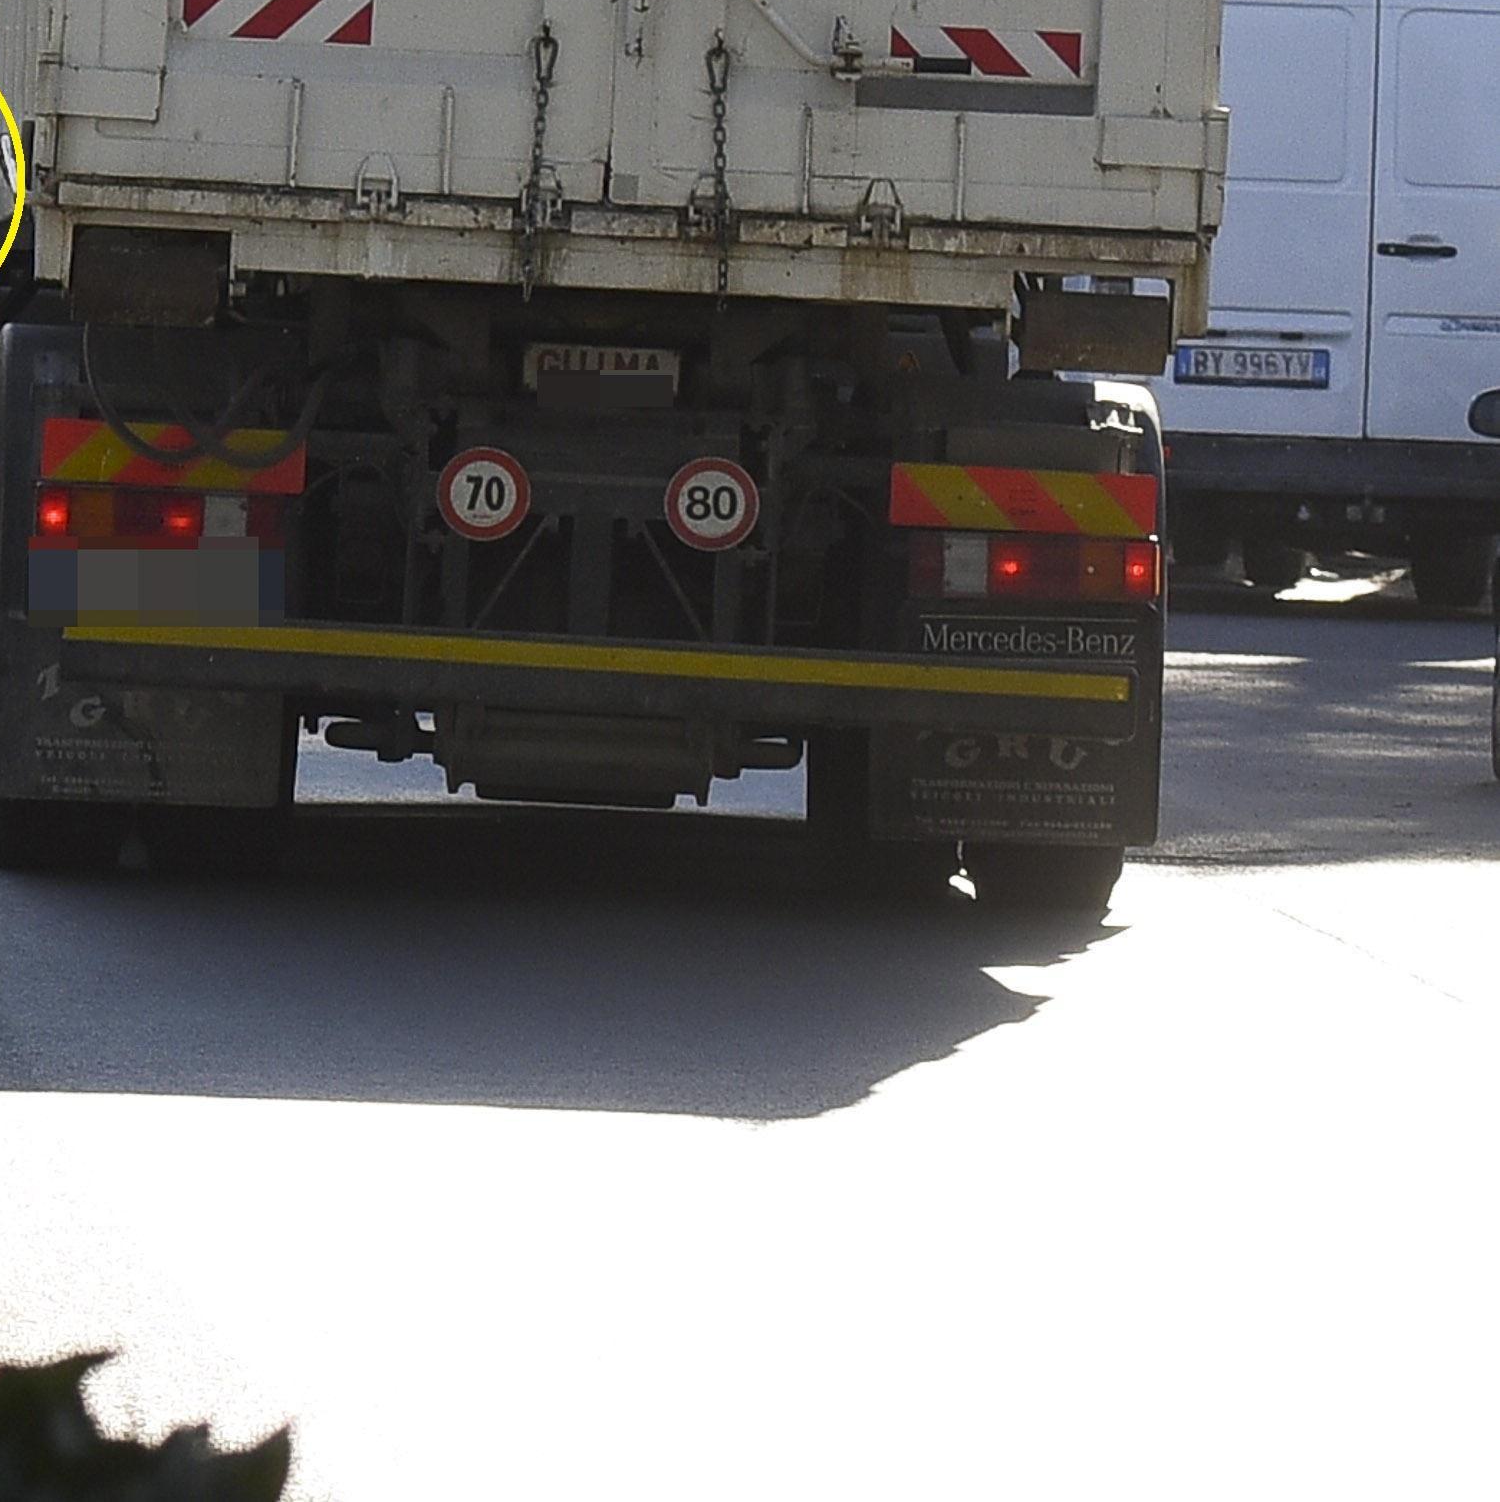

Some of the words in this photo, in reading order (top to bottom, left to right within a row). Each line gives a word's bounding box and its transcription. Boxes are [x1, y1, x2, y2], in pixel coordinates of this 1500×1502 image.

[465, 474, 506, 512] 70
[685, 485, 738, 521] 80
[922, 623, 1136, 655] Mercedes-Benz
